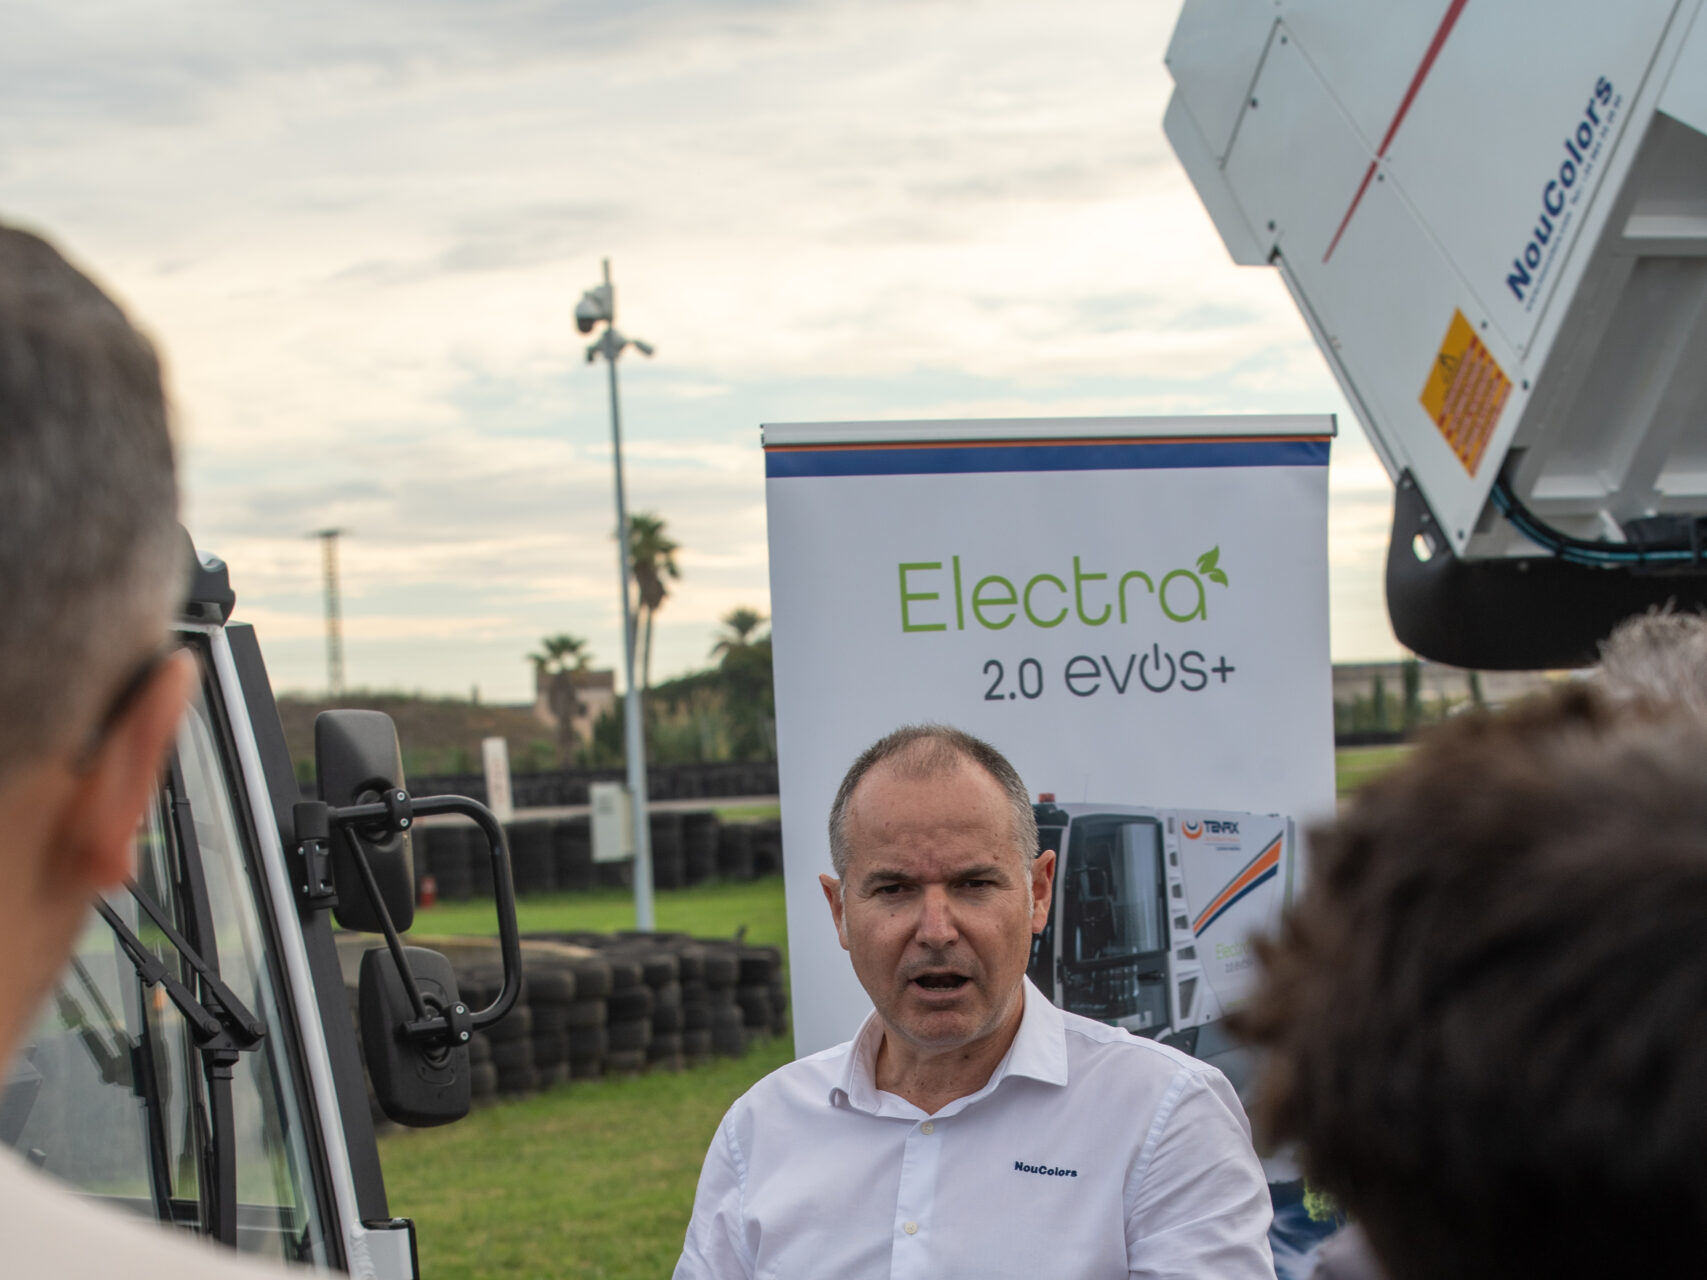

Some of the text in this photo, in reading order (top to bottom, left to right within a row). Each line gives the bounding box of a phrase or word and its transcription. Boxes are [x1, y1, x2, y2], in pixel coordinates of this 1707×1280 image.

[1506, 76, 1613, 301] NouColors
[898, 555, 1208, 633] Electra
[982, 657, 1044, 701] 2.0
[1014, 1160, 1078, 1178] NouColors
